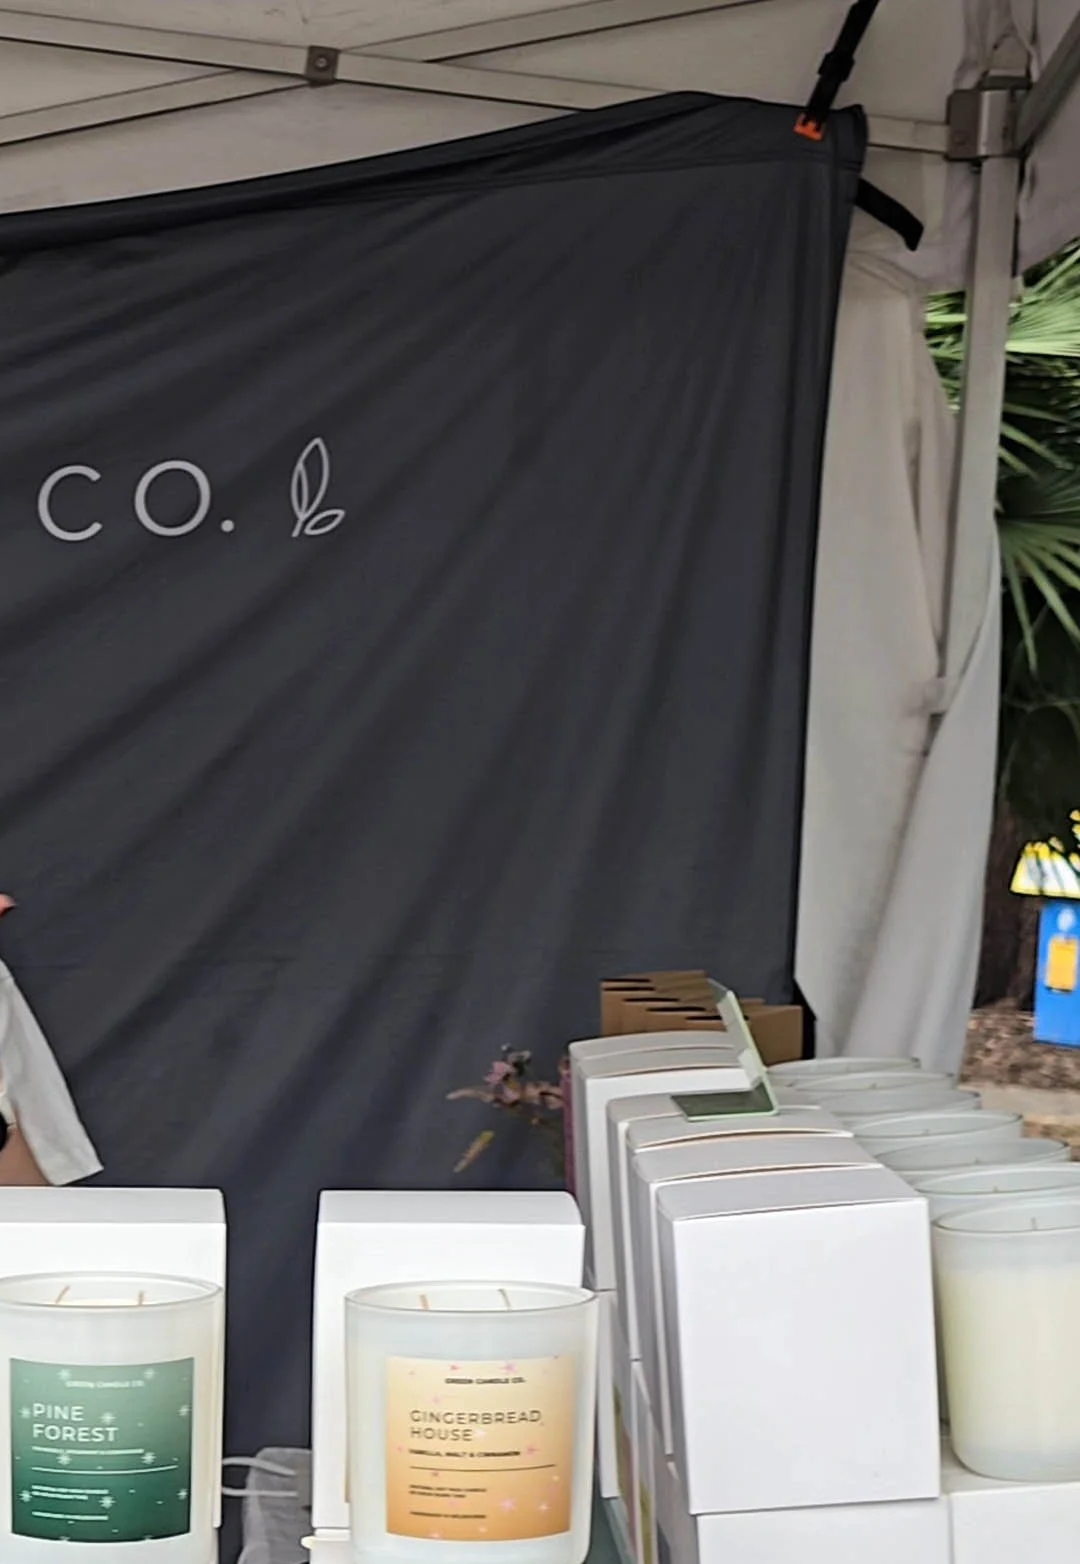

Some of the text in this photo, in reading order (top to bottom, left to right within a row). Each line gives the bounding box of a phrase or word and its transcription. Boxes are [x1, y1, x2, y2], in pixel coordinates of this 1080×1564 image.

[37, 460, 235, 541] CO.
[32, 1402, 85, 1421] PINE
[409, 1409, 542, 1425] GINGERBREAD
[32, 1423, 119, 1442] FOREST
[410, 1427, 473, 1442] HOUSE
